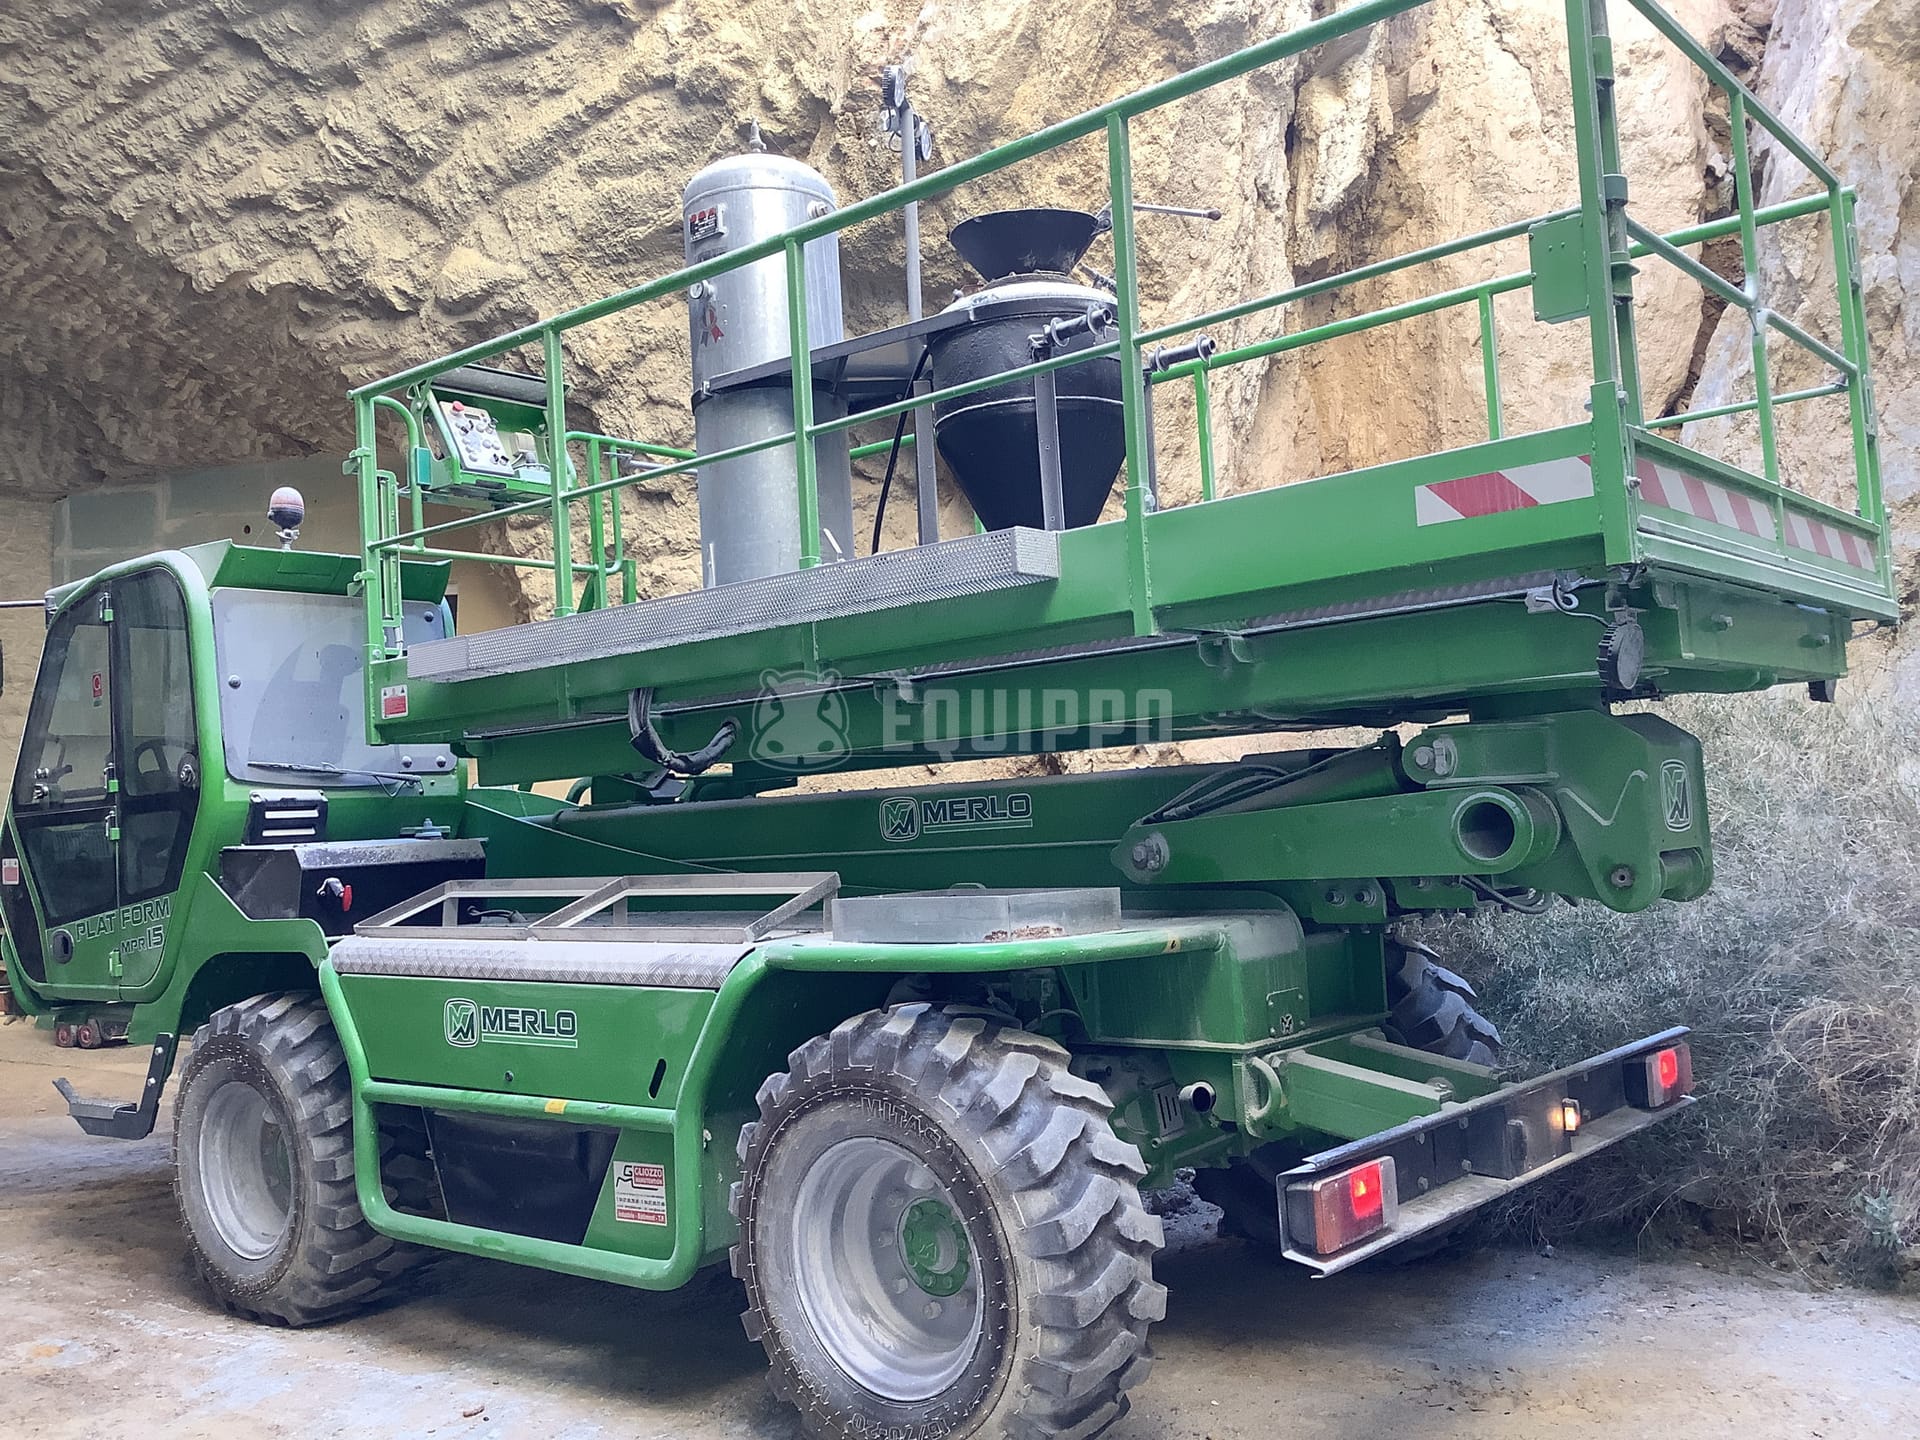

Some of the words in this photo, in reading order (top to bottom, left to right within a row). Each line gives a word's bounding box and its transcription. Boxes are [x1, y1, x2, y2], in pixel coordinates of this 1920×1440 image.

[921, 793, 1033, 825] MERLO
[481, 1006, 577, 1038] MERLO
[861, 1097, 941, 1149] MITAS
